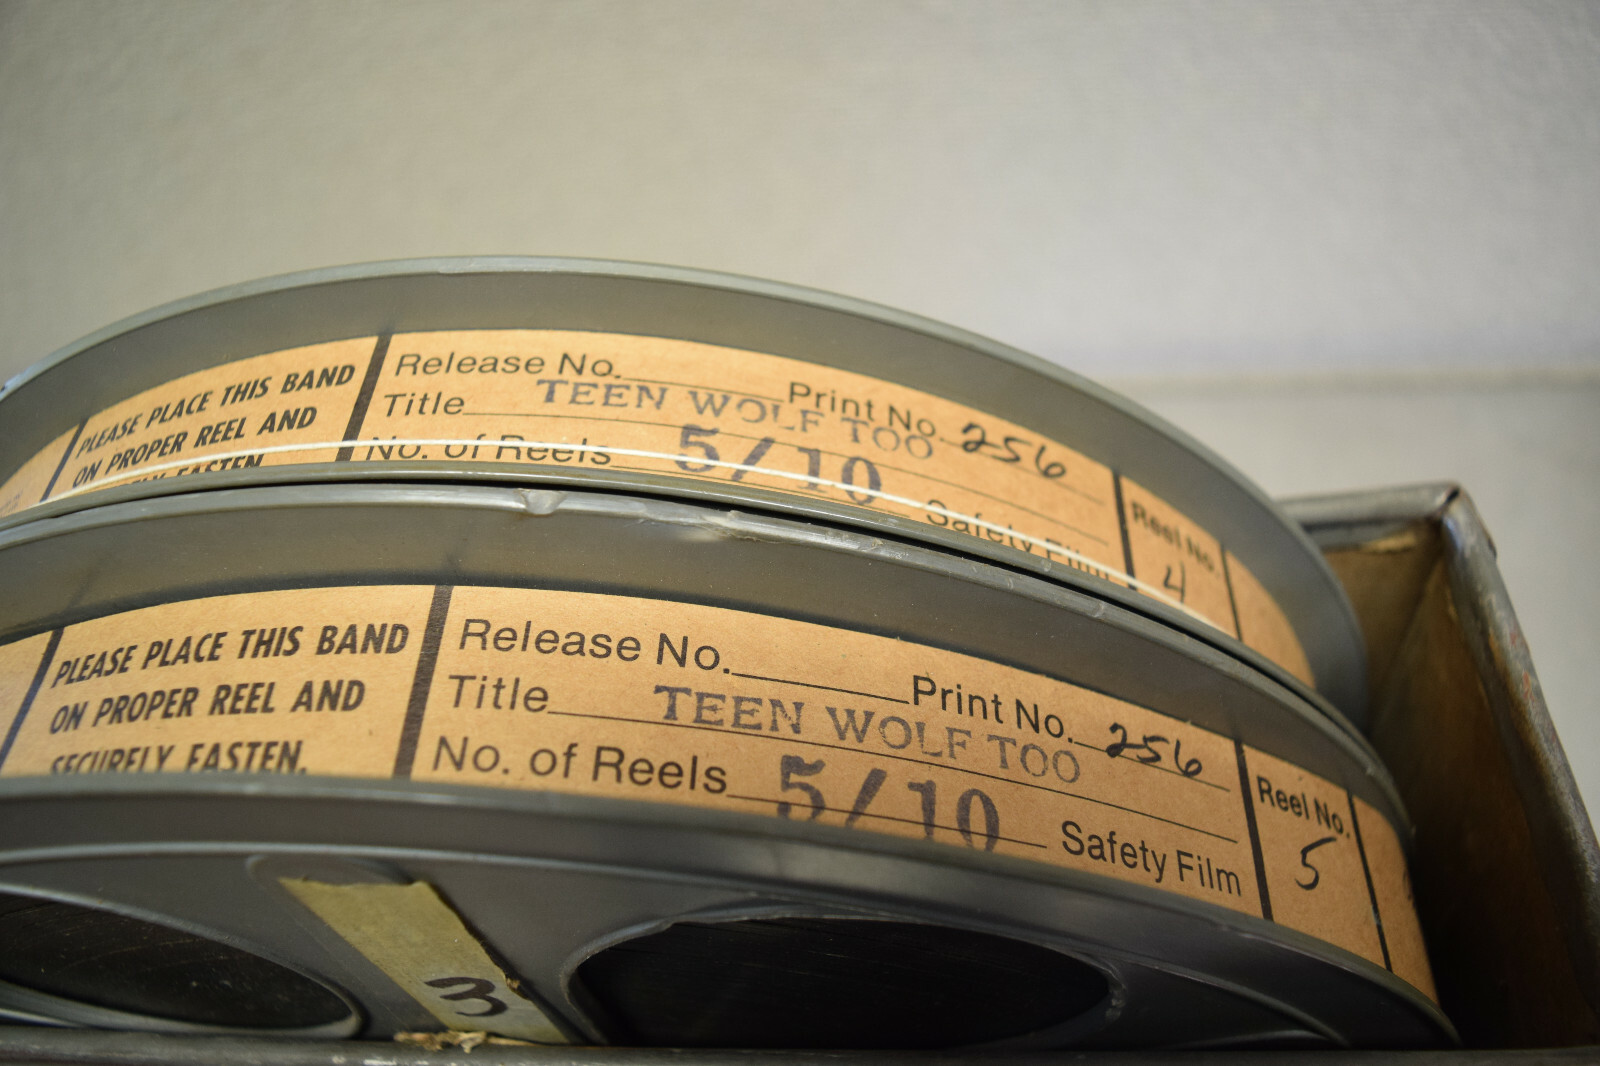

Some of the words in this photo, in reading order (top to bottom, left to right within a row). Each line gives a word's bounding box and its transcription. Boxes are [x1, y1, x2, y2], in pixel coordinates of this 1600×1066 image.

[394, 351, 545, 377] Release
[557, 352, 623, 379] No.
[76, 413, 141, 459] PLEASE
[145, 391, 213, 430] PLACE
[220, 376, 272, 408] THIS
[281, 364, 355, 394] BAND
[384, 391, 465, 417] Title
[536, 379, 668, 410] TEEN
[688, 390, 825, 433] WOLF
[841, 416, 934, 460] TOO
[789, 381, 875, 422] Print
[889, 404, 946, 442] No.
[72, 461, 103, 489] ON
[105, 432, 188, 475] PROPER
[197, 419, 247, 448] REEL
[260, 406, 317, 434] AND
[366, 435, 428, 461] No.
[444, 433, 487, 459] of
[495, 434, 612, 465] Reels
[961, 421, 1067, 480] 256
[1132, 501, 1181, 548] Reel
[1163, 560, 1187, 604] 4
[51, 645, 137, 688] PLEASE
[141, 631, 228, 670] PLACE
[236, 625, 304, 659] THIS
[315, 622, 410, 656] BAND
[458, 618, 641, 662] Release
[656, 633, 731, 675] No.
[49, 702, 88, 735] ON
[92, 686, 200, 728] PROPER
[208, 681, 276, 715] REEL
[290, 679, 366, 713] AND
[448, 674, 549, 713] Title
[912, 675, 1003, 725] Print
[1015, 699, 1074, 744] No.
[654, 684, 804, 734] TEEN
[825, 705, 972, 760] WOLF
[987, 734, 1081, 784] TOO
[1105, 722, 1203, 778] 256
[432, 735, 510, 775] No.
[529, 743, 578, 779] of
[592, 745, 727, 794] Reels
[1257, 775, 1310, 820] Reel
[1314, 798, 1350, 839] No.
[1060, 820, 1167, 884] Safety
[1177, 850, 1242, 896] Film
[1295, 836, 1337, 891] 5
[424, 975, 508, 1018] 3
